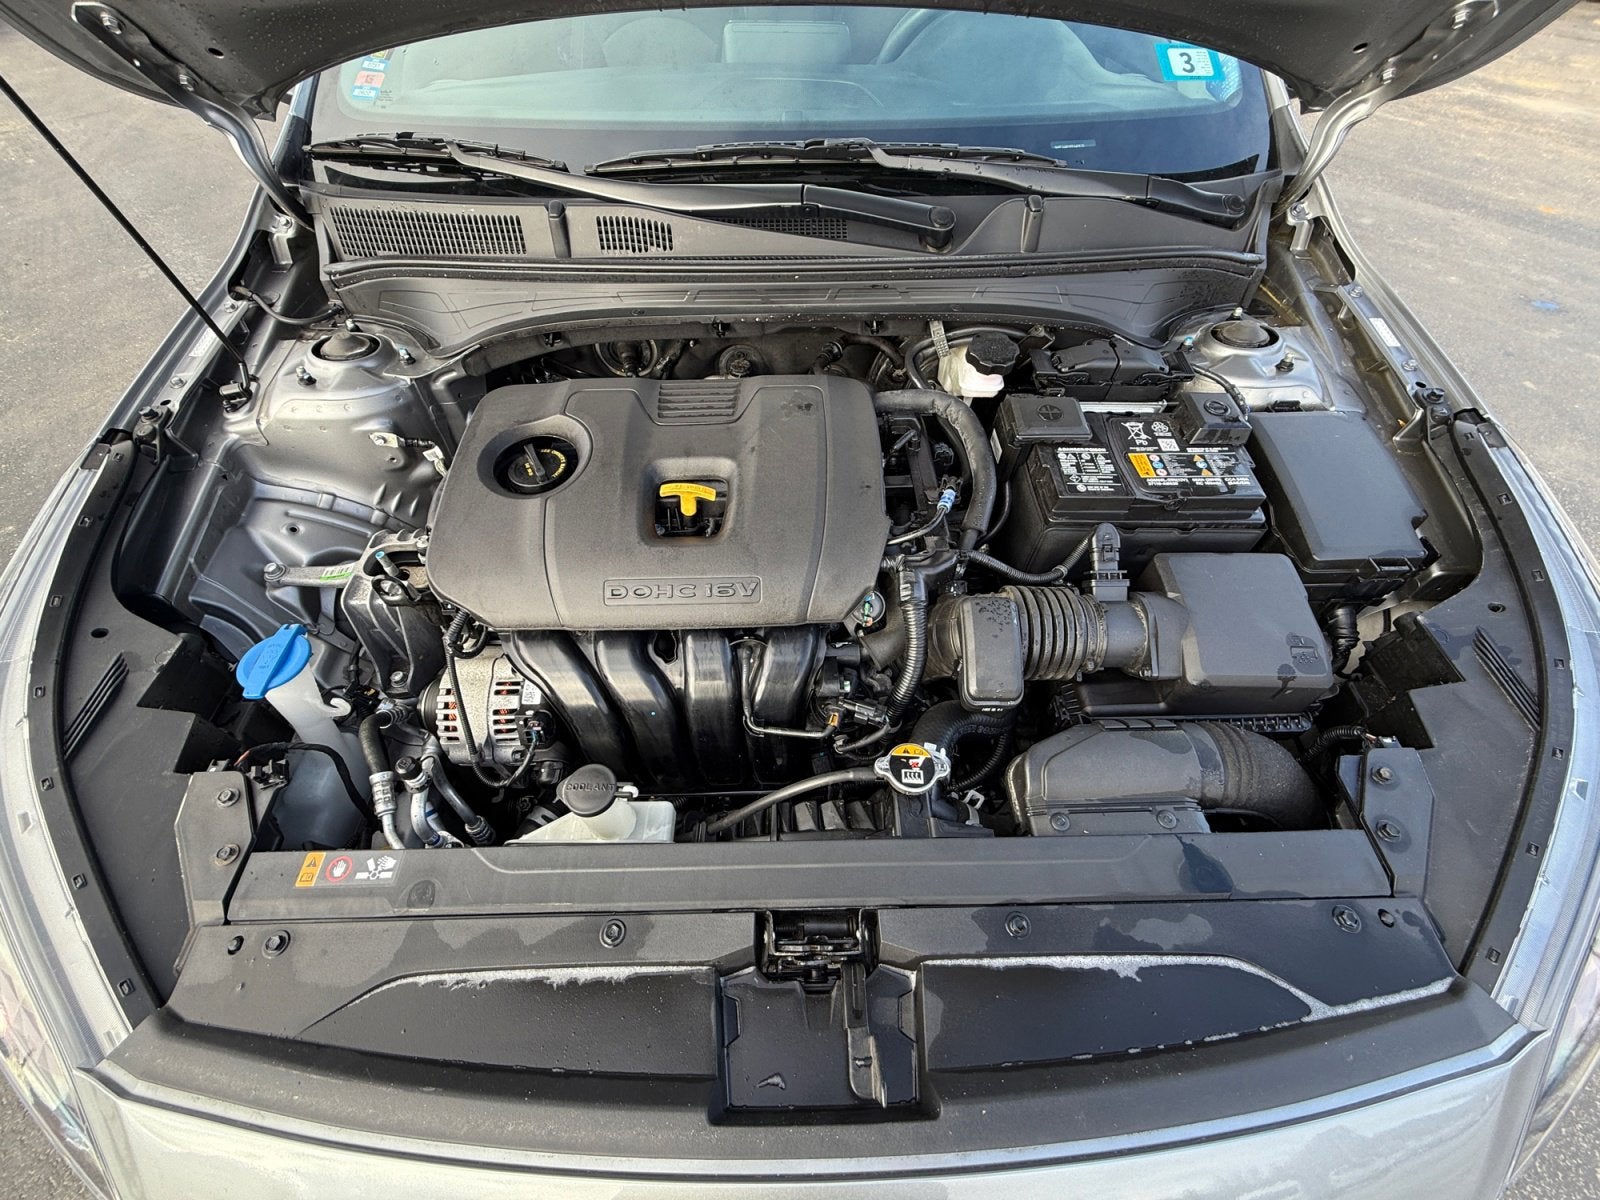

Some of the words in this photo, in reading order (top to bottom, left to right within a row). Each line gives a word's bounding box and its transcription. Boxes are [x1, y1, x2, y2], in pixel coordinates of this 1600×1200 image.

[1179, 52, 1195, 73] 3
[606, 584, 697, 600] DOHC
[704, 582, 759, 598] 16V
[566, 782, 615, 792] COOLANT
